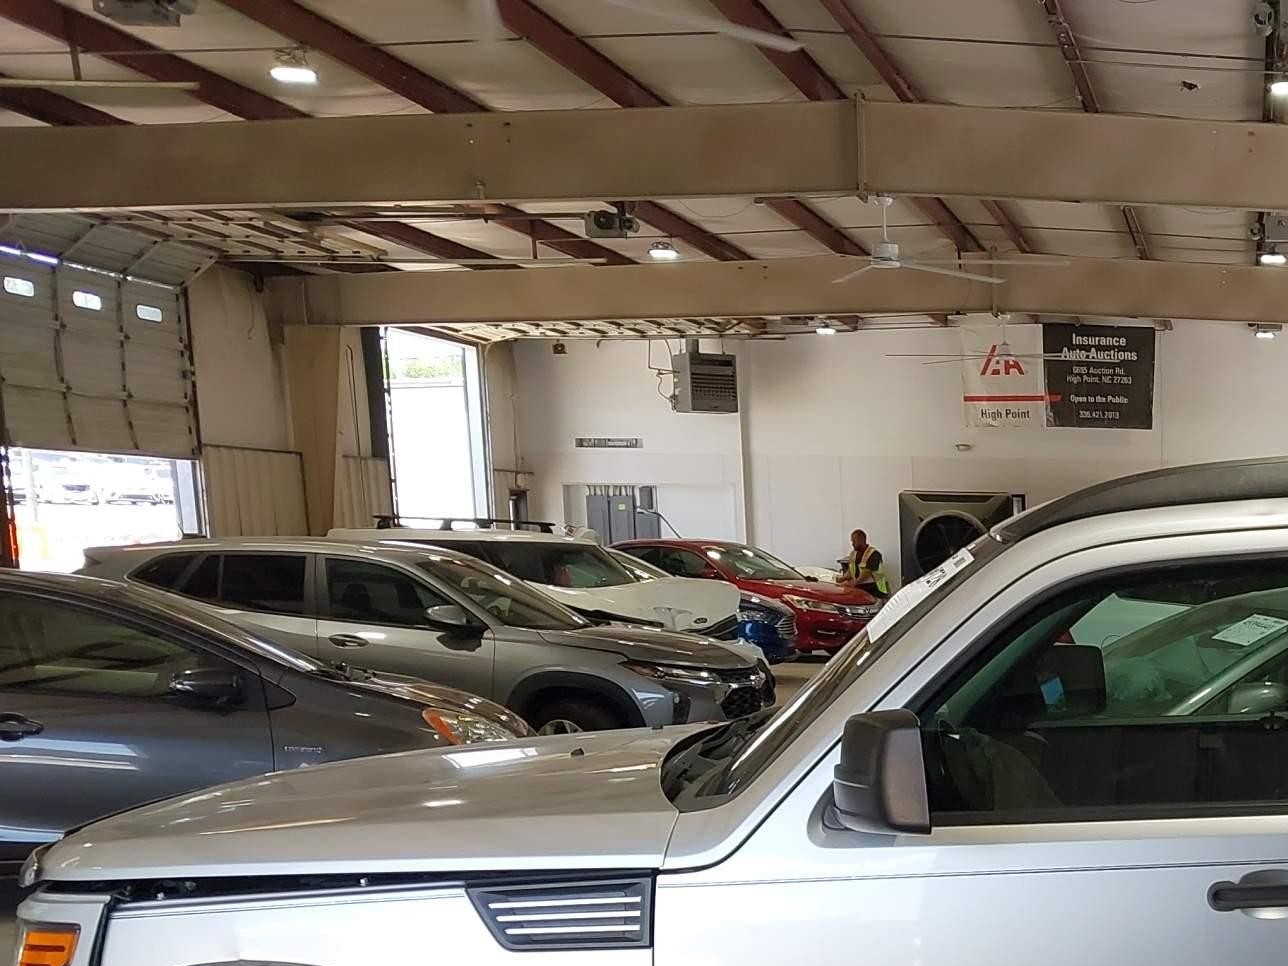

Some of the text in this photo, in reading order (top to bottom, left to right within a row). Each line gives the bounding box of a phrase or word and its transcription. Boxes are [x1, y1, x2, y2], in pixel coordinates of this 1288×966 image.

[1072, 333, 1126, 346] Insurance
[1061, 347, 1137, 361] Auto Auctions
[1067, 375, 1081, 384] High
[1070, 395, 1086, 403] Open
[1107, 395, 1128, 403] Public
[980, 408, 1030, 420] High Point
